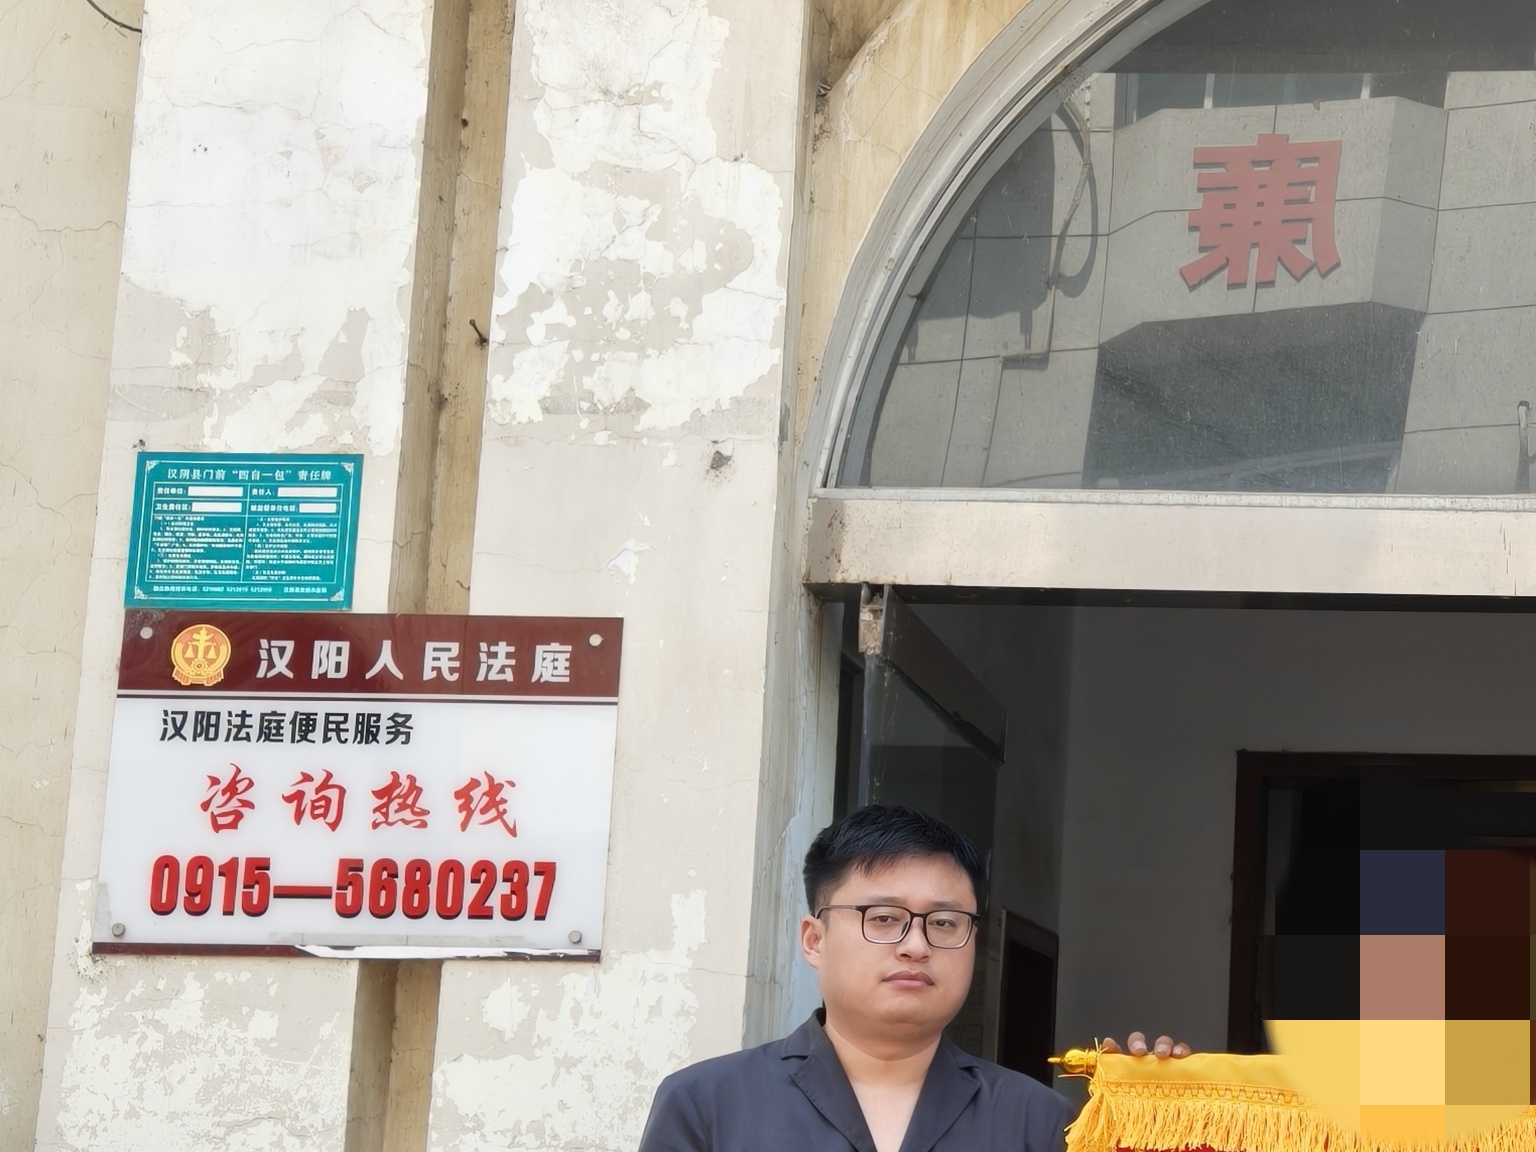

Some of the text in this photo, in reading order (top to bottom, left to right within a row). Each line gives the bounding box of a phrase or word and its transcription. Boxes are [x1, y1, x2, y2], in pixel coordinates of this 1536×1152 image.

[256, 638, 573, 684] 汉阳人民法庭
[159, 709, 414, 746] 汉阳法庭便民服务
[200, 763, 518, 838] 咨询热线
